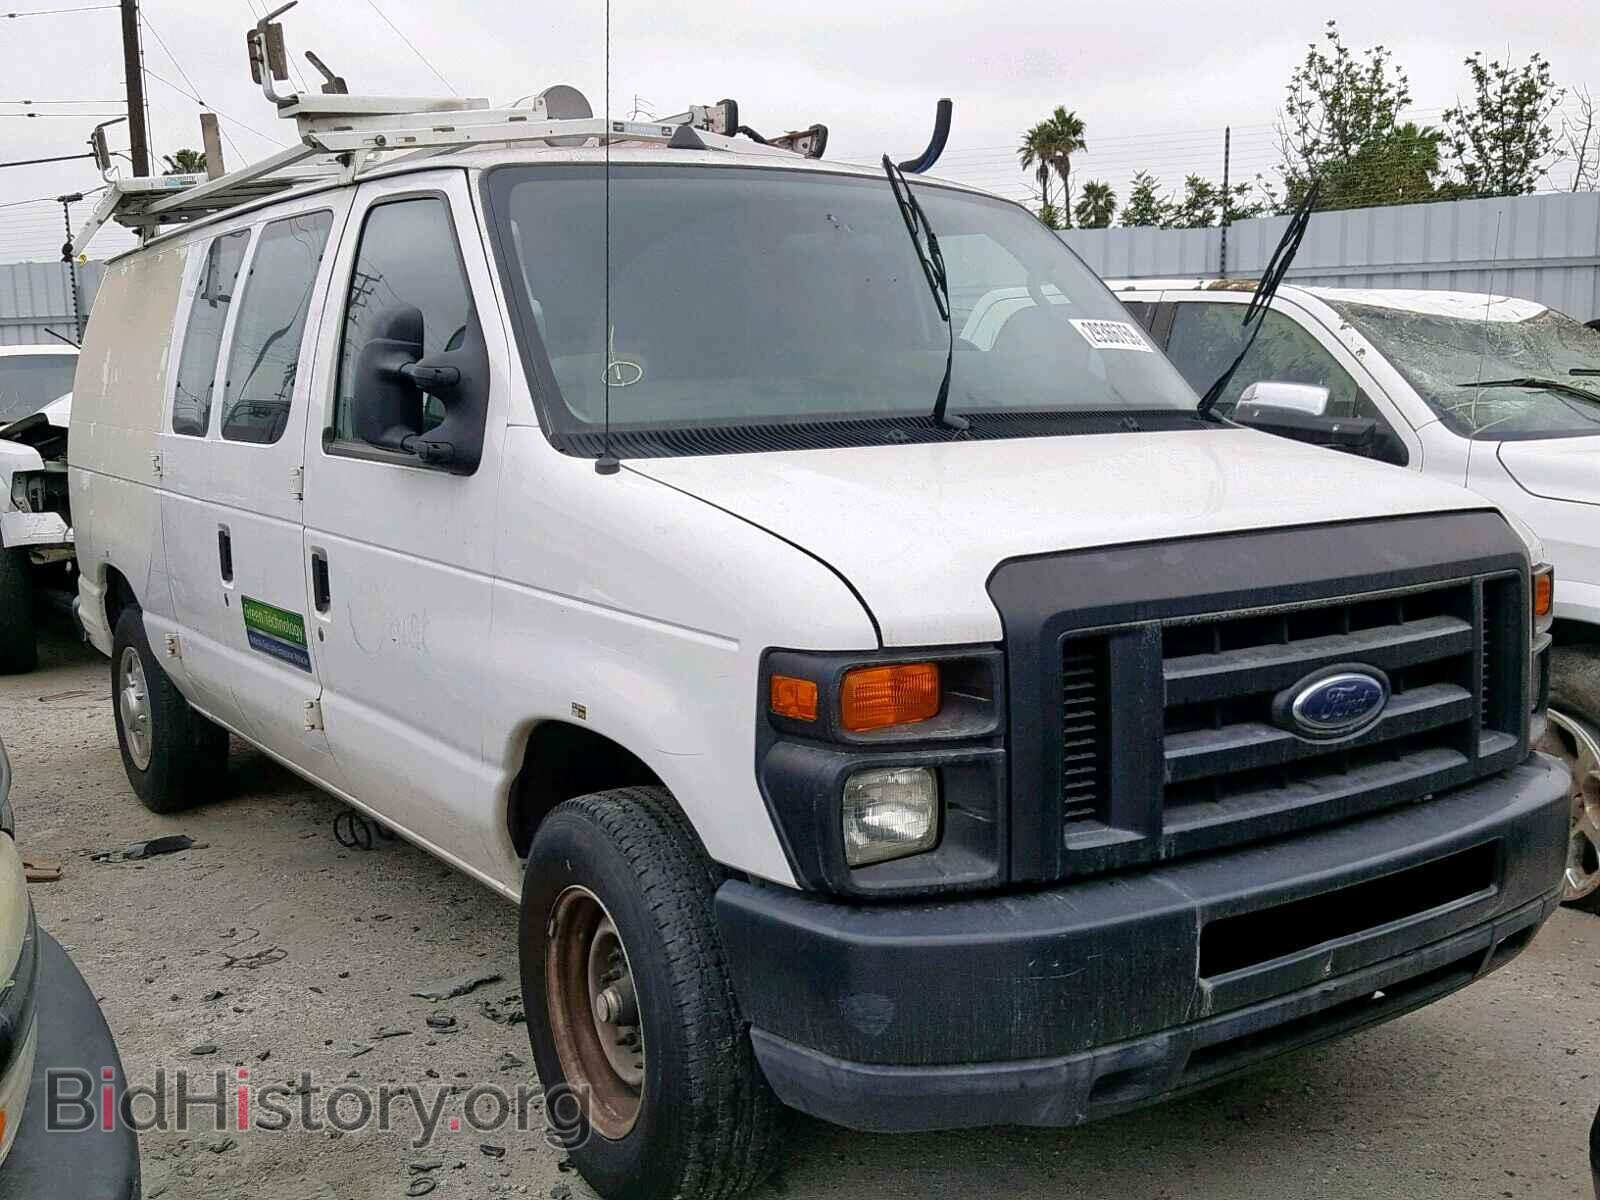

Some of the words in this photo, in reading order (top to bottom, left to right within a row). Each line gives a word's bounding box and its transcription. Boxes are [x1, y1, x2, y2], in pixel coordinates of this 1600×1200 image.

[244, 603, 264, 625] Green
[263, 609, 303, 644] Technology
[1319, 684, 1370, 719] Ford
